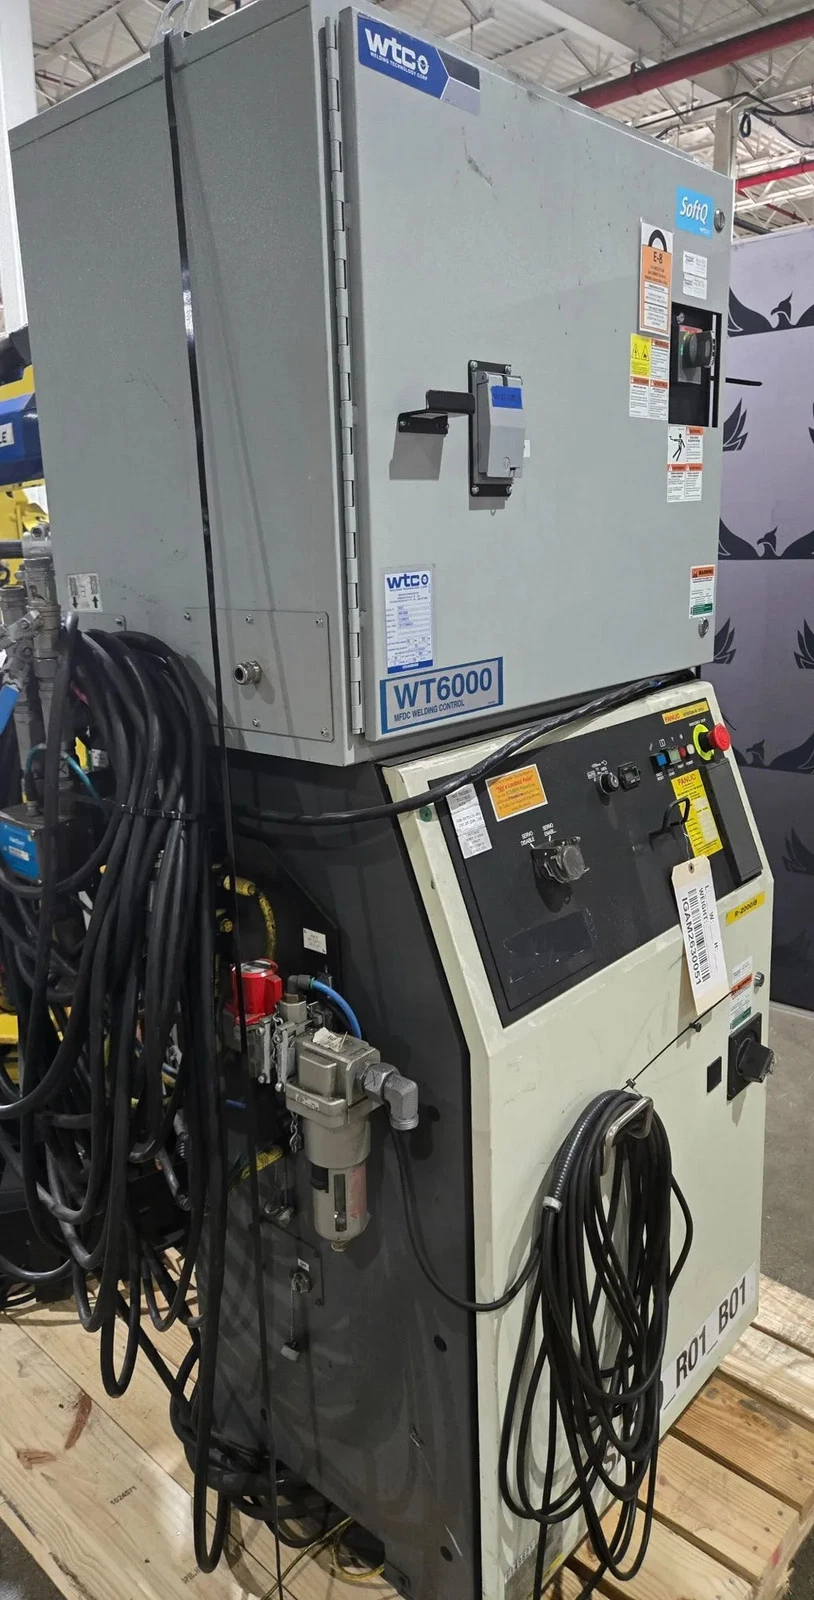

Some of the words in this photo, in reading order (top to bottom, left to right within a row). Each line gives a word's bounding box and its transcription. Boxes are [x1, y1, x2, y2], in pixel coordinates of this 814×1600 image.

[680, 196, 708, 225] SoftQ
[393, 667, 492, 710] WT6000
[394, 712, 411, 722] MFDC
[412, 704, 438, 718] WELDING
[438, 700, 465, 712] CONTROL
[678, 774, 696, 785] FANUC
[699, 888, 708, 924] WEIGHT:
[682, 898, 702, 986] IGAM2630051
